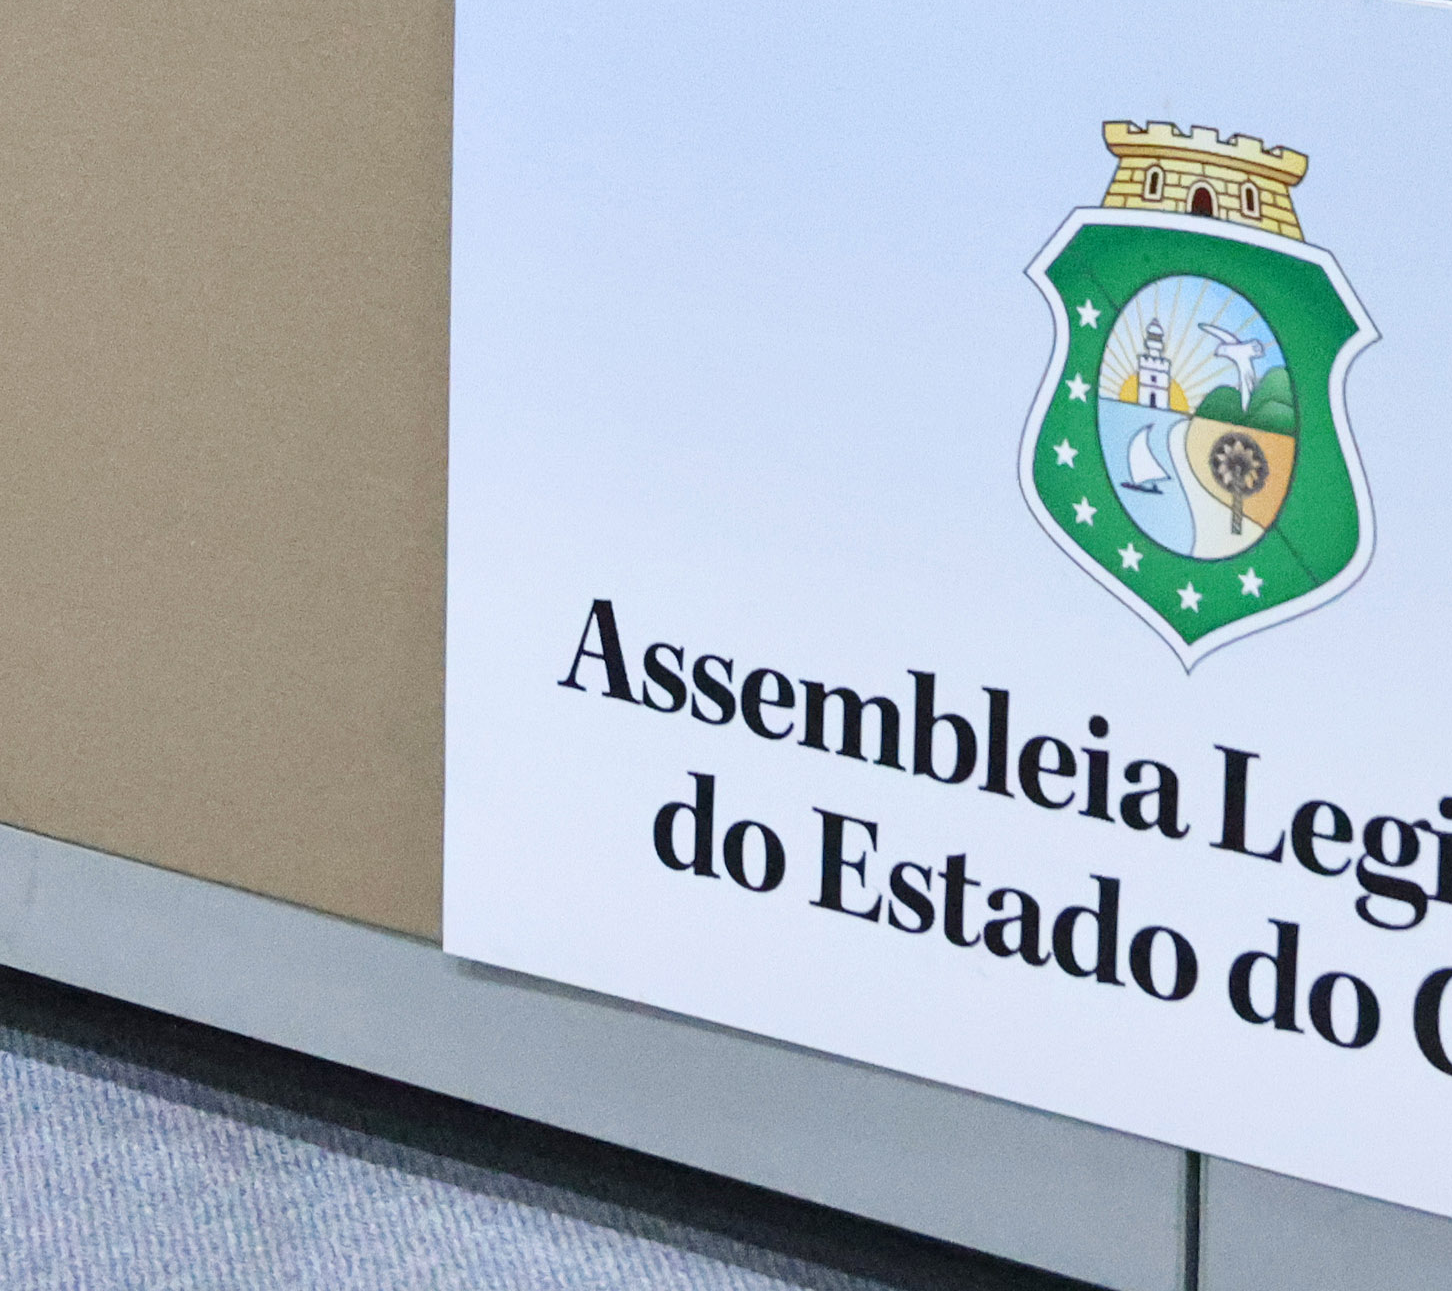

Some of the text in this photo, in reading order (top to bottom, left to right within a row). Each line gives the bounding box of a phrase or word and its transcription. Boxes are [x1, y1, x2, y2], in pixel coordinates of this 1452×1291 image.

[558, 600, 1189, 838] Assembleia
[654, 772, 785, 892] do
[810, 808, 1197, 1000] Estado
[1229, 919, 1379, 1048] do
